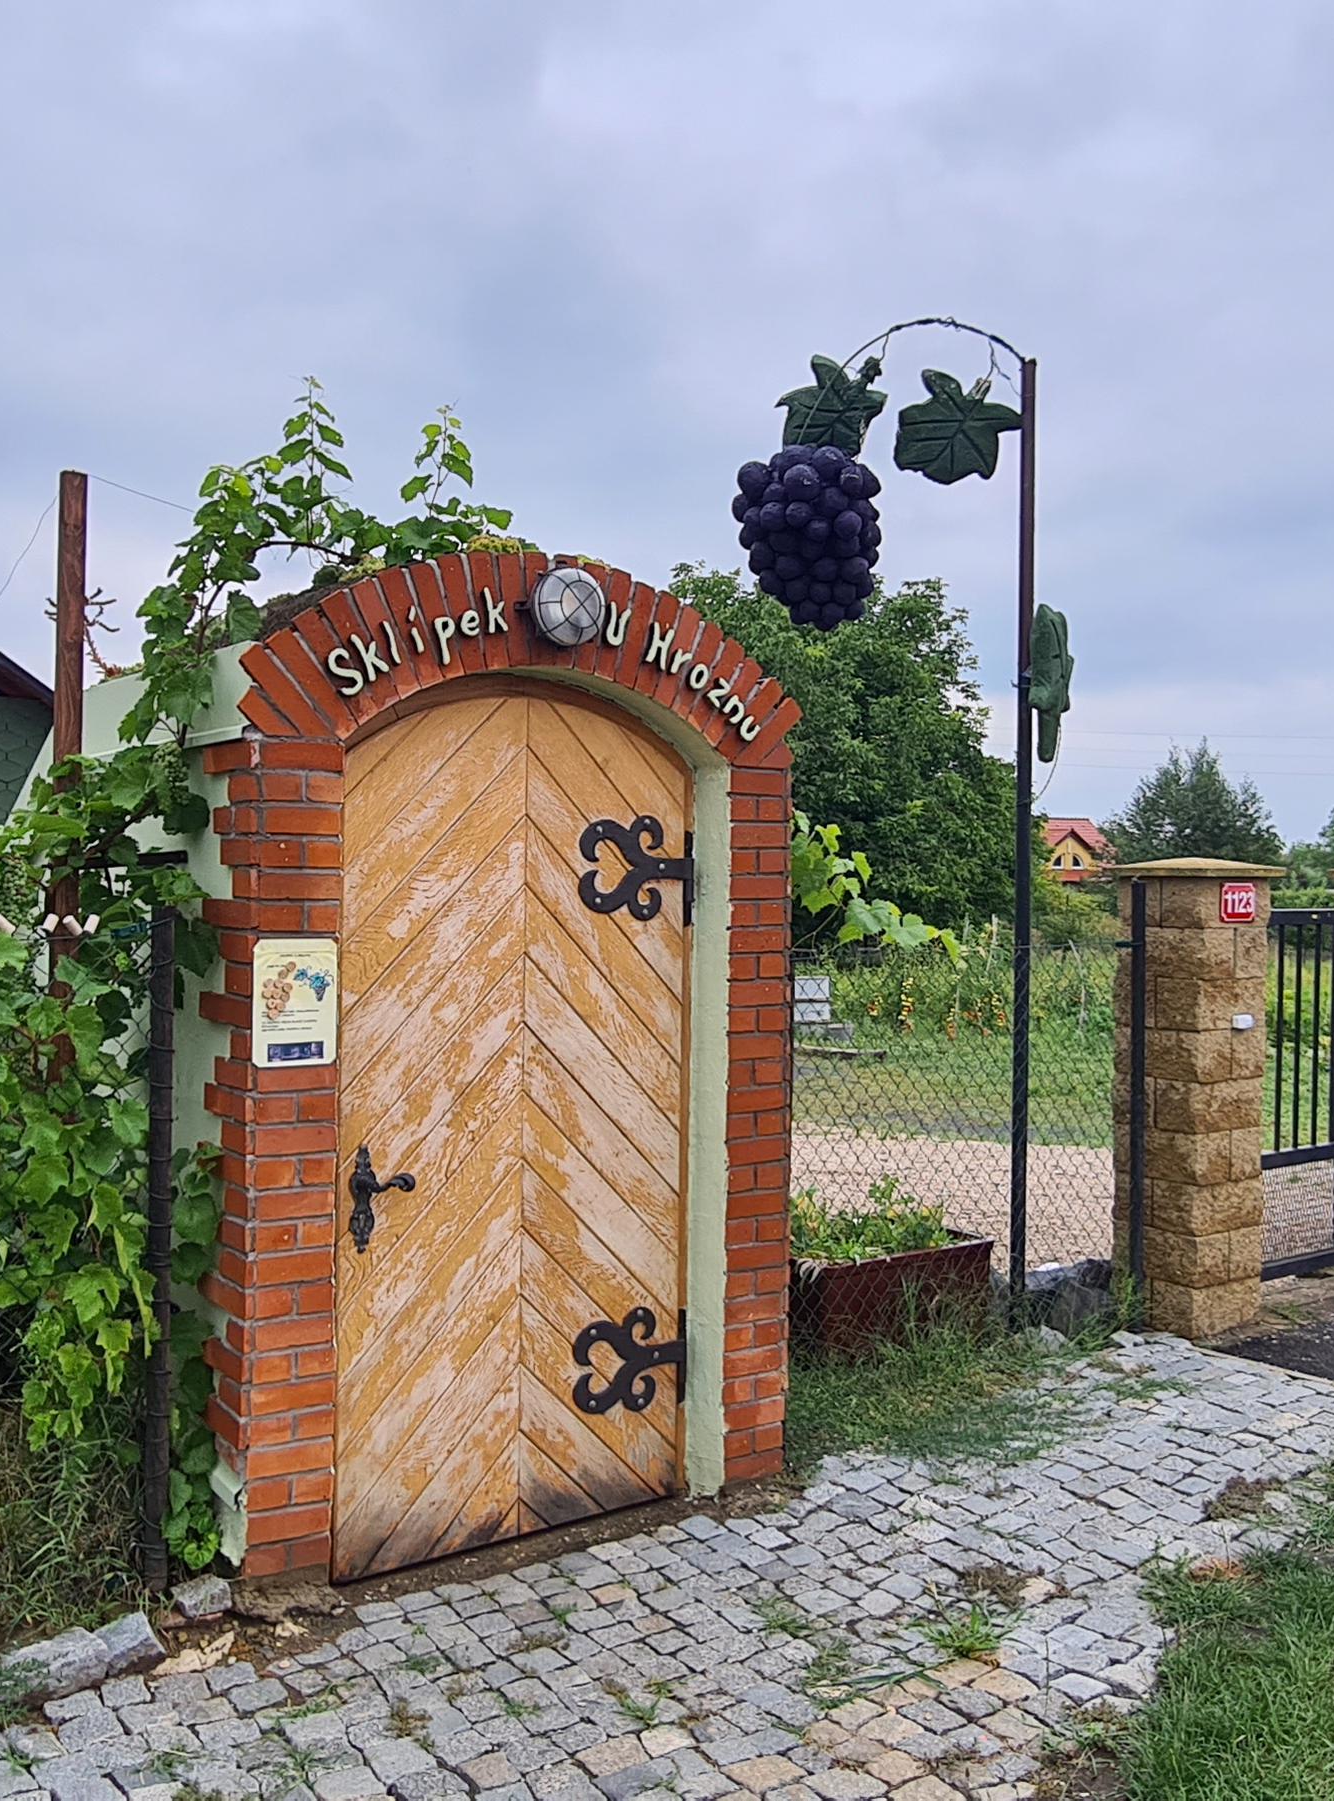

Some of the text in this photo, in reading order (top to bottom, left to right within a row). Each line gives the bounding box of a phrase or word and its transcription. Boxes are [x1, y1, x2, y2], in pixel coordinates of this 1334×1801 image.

[328, 588, 509, 695] Sklípek
[606, 601, 632, 646] U
[1224, 892, 1254, 913] 1123
